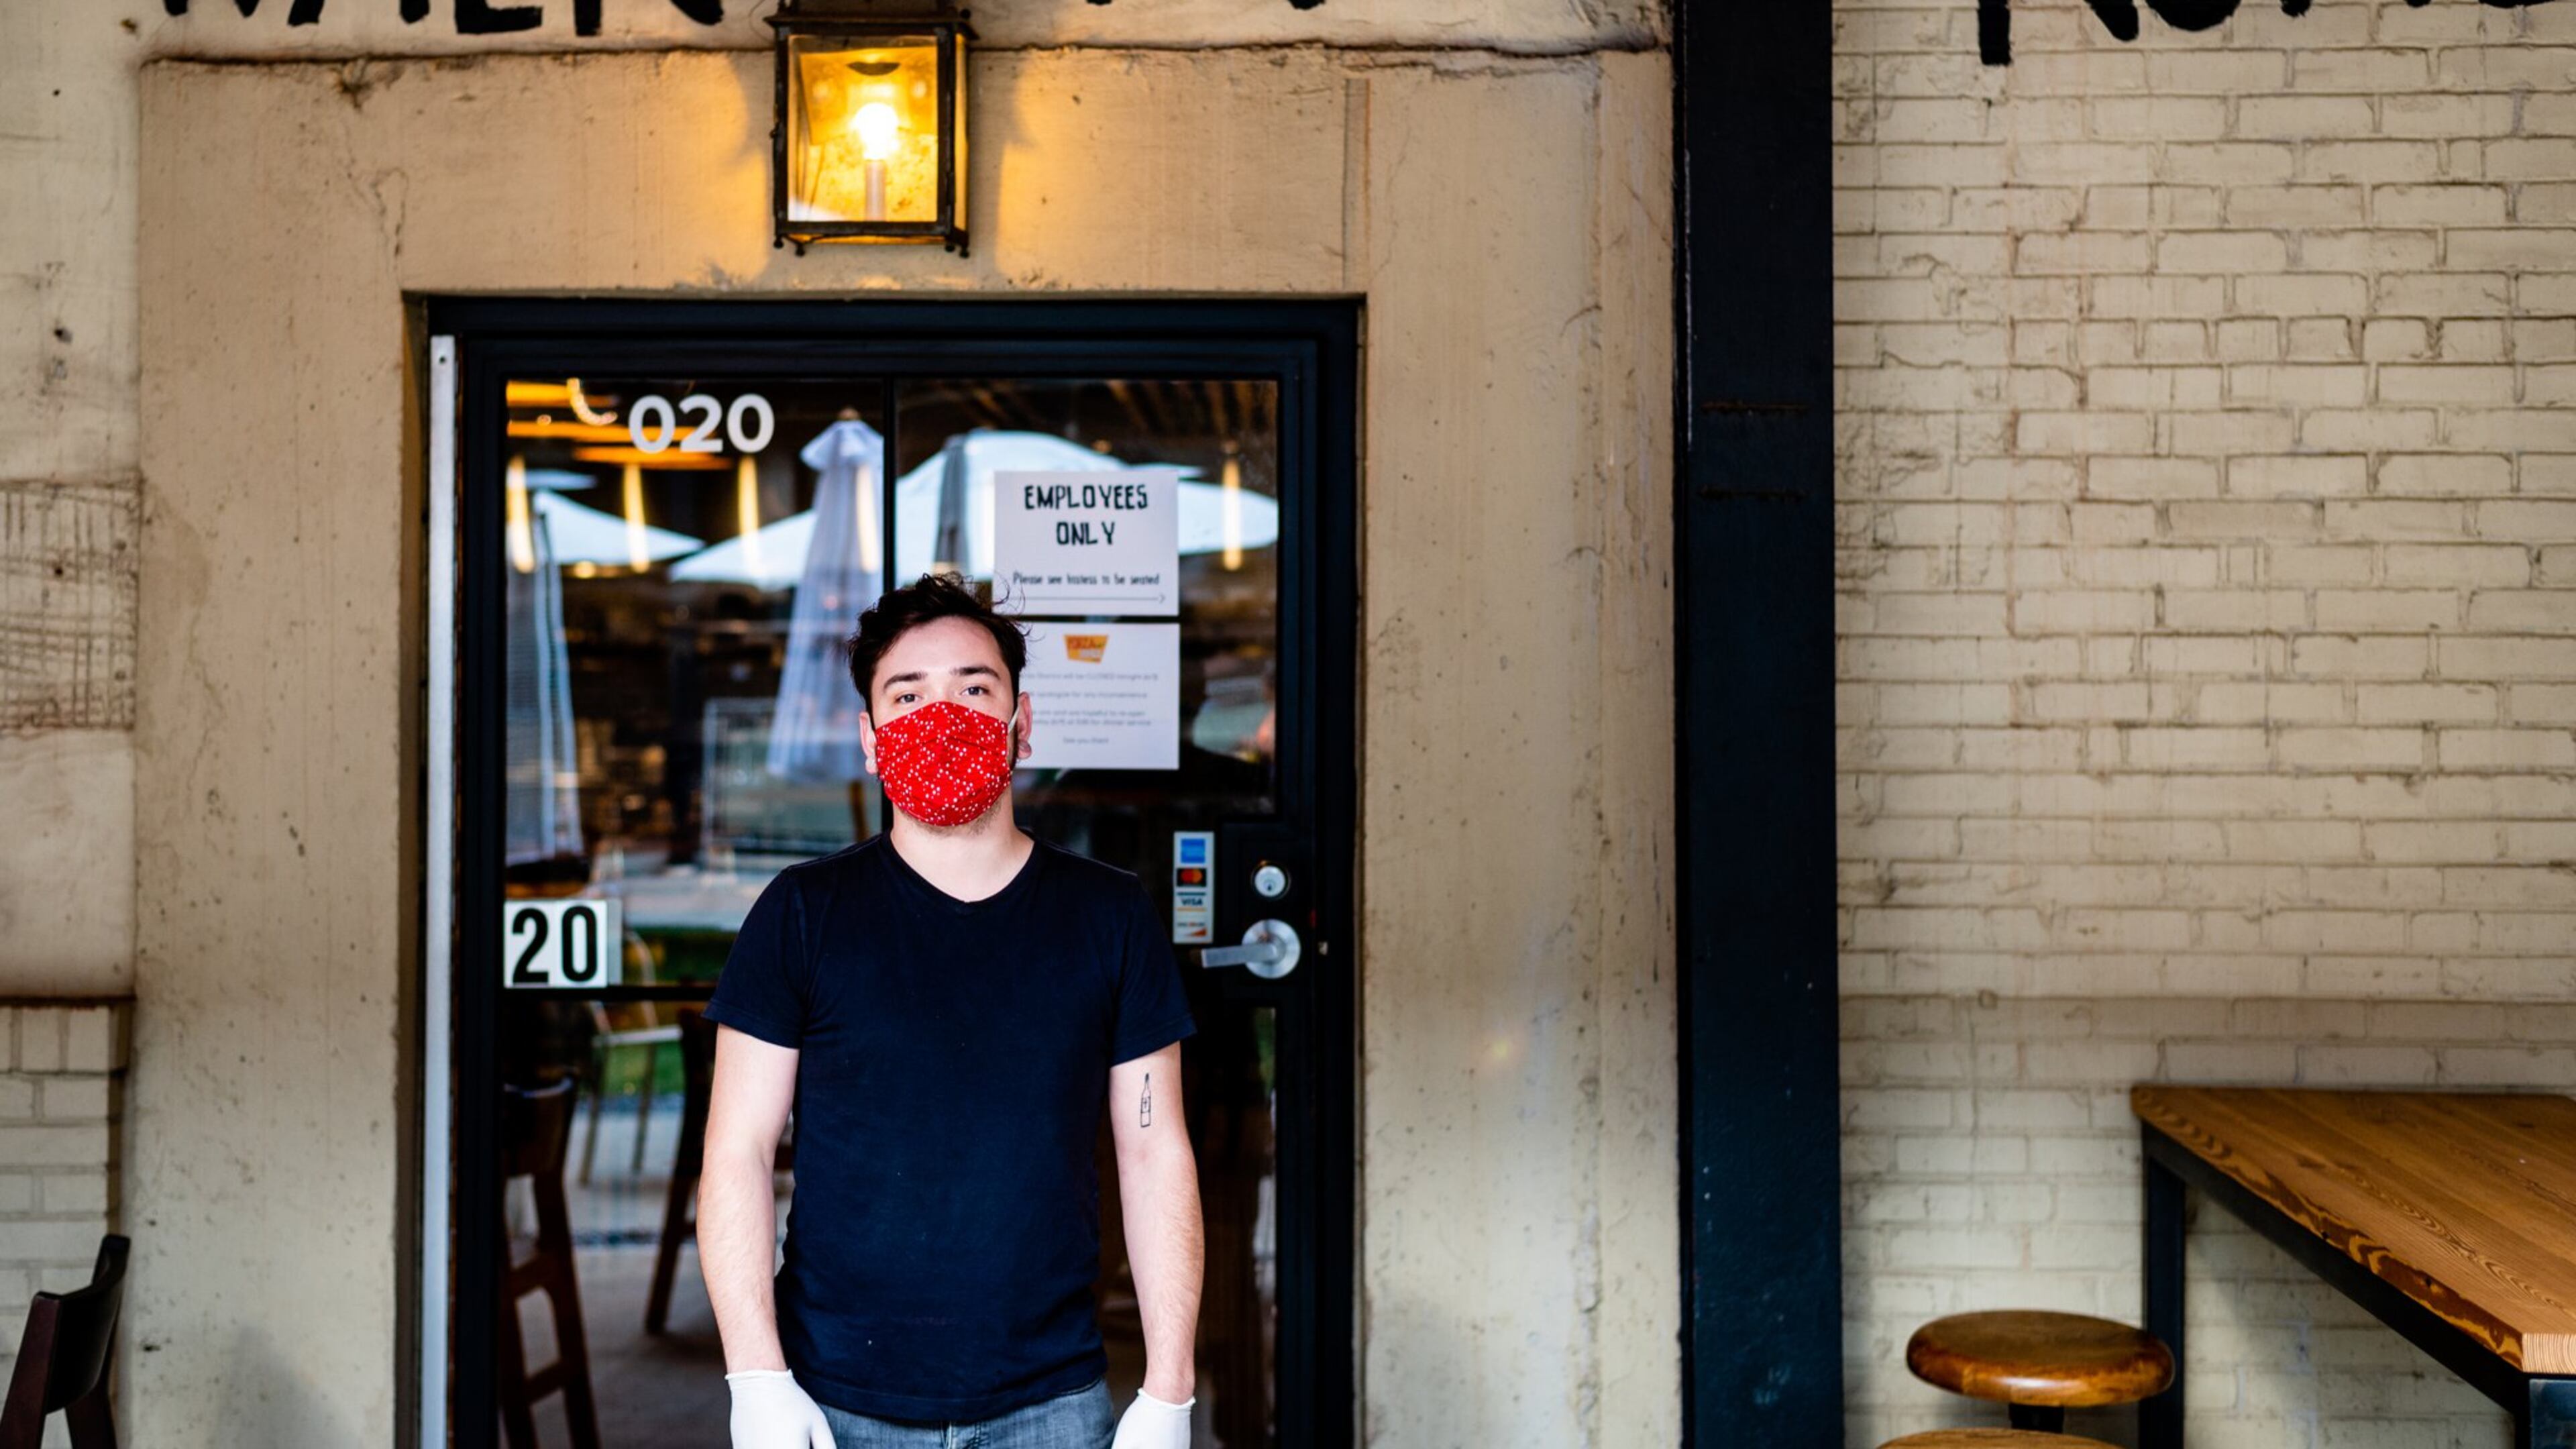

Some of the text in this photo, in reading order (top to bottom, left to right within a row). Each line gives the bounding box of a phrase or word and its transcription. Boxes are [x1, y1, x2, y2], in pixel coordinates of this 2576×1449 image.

[628, 393, 775, 454] 020
[1024, 484, 1148, 510] EMPLOYEES
[1057, 522, 1116, 545] ONLY
[1013, 571, 1042, 585] Please
[1130, 572, 1160, 585] seated
[512, 905, 598, 983] 20
